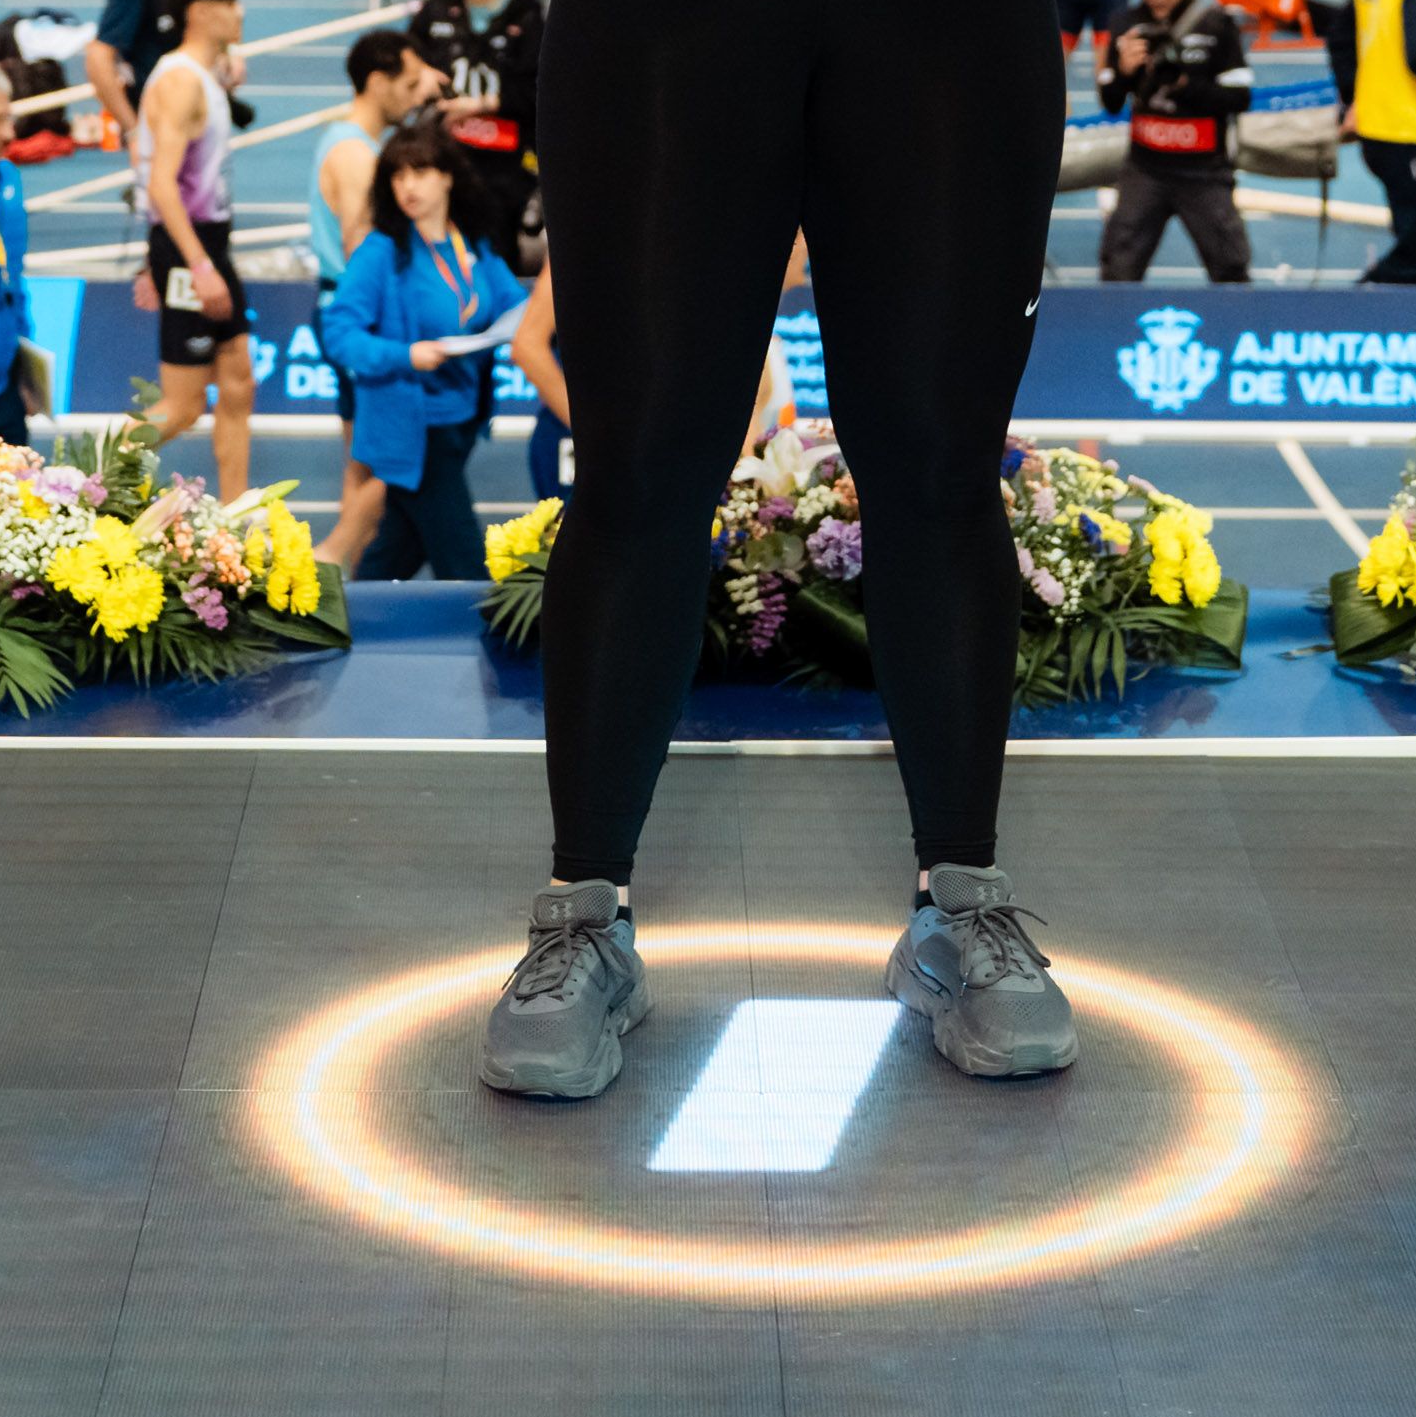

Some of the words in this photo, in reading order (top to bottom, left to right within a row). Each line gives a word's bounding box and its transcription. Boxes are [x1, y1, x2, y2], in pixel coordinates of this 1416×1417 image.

[284, 364, 339, 399] DE
[1229, 370, 1287, 406] DE
[647, 997, 907, 1172] 1
